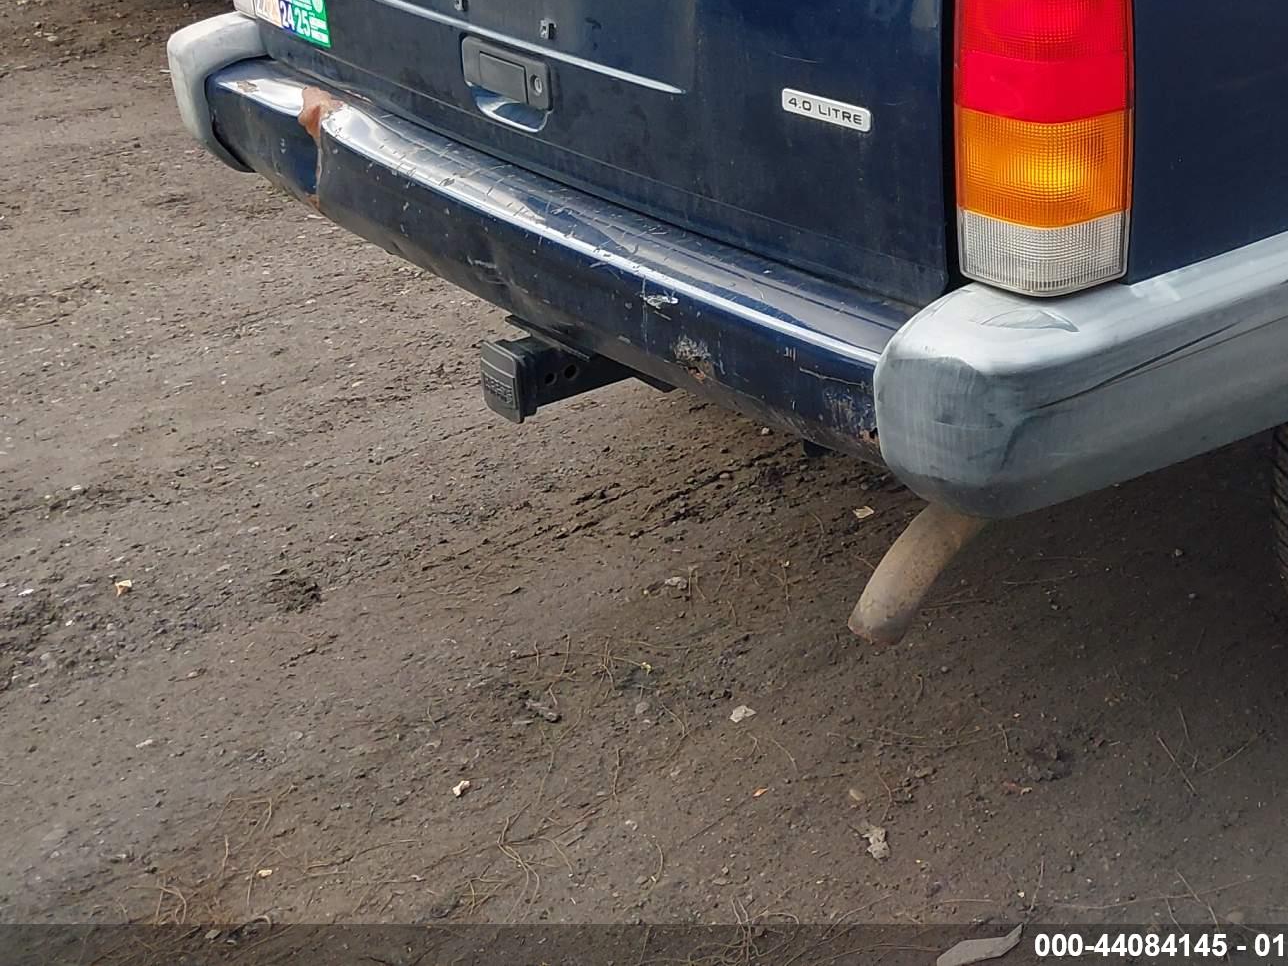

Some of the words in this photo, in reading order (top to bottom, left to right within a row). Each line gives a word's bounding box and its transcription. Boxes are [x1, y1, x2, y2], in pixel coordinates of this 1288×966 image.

[280, 0, 295, 31] 24
[294, 7, 311, 38] 25
[788, 97, 812, 112] 4.0
[818, 104, 862, 125] LITRE
